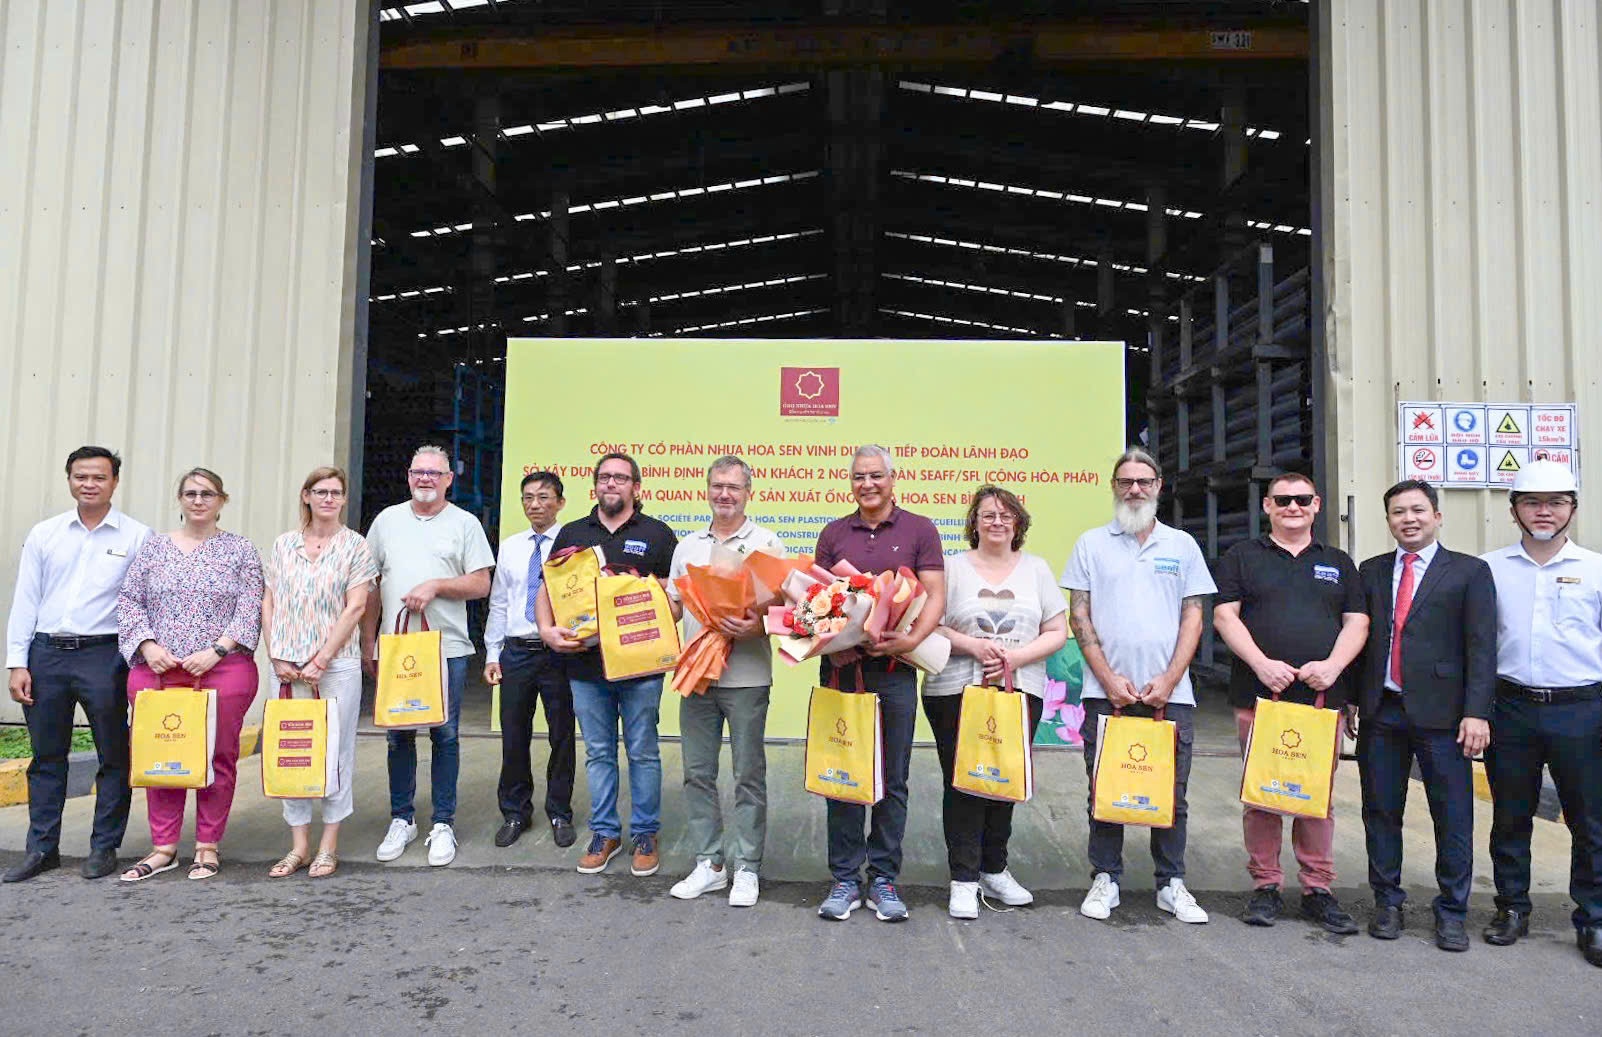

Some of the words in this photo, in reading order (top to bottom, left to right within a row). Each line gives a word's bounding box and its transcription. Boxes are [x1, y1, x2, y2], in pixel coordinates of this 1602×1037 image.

[590, 441, 627, 455] CÔNG
[631, 444, 644, 455] TY
[747, 444, 775, 456] HOA
[779, 444, 802, 456] SEN
[806, 445, 836, 457] VINH
[895, 443, 917, 458] TIẾP
[921, 444, 959, 458] ĐOÀN
[963, 445, 997, 459] LÃNH
[1000, 447, 1029, 462] ĐẠO
[642, 464, 670, 478] BÌNH
[674, 467, 704, 480] ĐỊNH
[770, 465, 814, 480] KHÁCH
[817, 468, 825, 480] 2
[920, 469, 980, 483] SEAFF/SFL
[985, 469, 1027, 485] (CỘNG
[1031, 469, 1060, 483] HÒA
[1063, 469, 1099, 486] PHÁP)
[656, 490, 692, 502] QUAN
[901, 493, 929, 504] HOA
[933, 493, 956, 505] SEN
[694, 514, 711, 523] PAR
[755, 515, 776, 524] HOA
[778, 515, 795, 524] SEN
